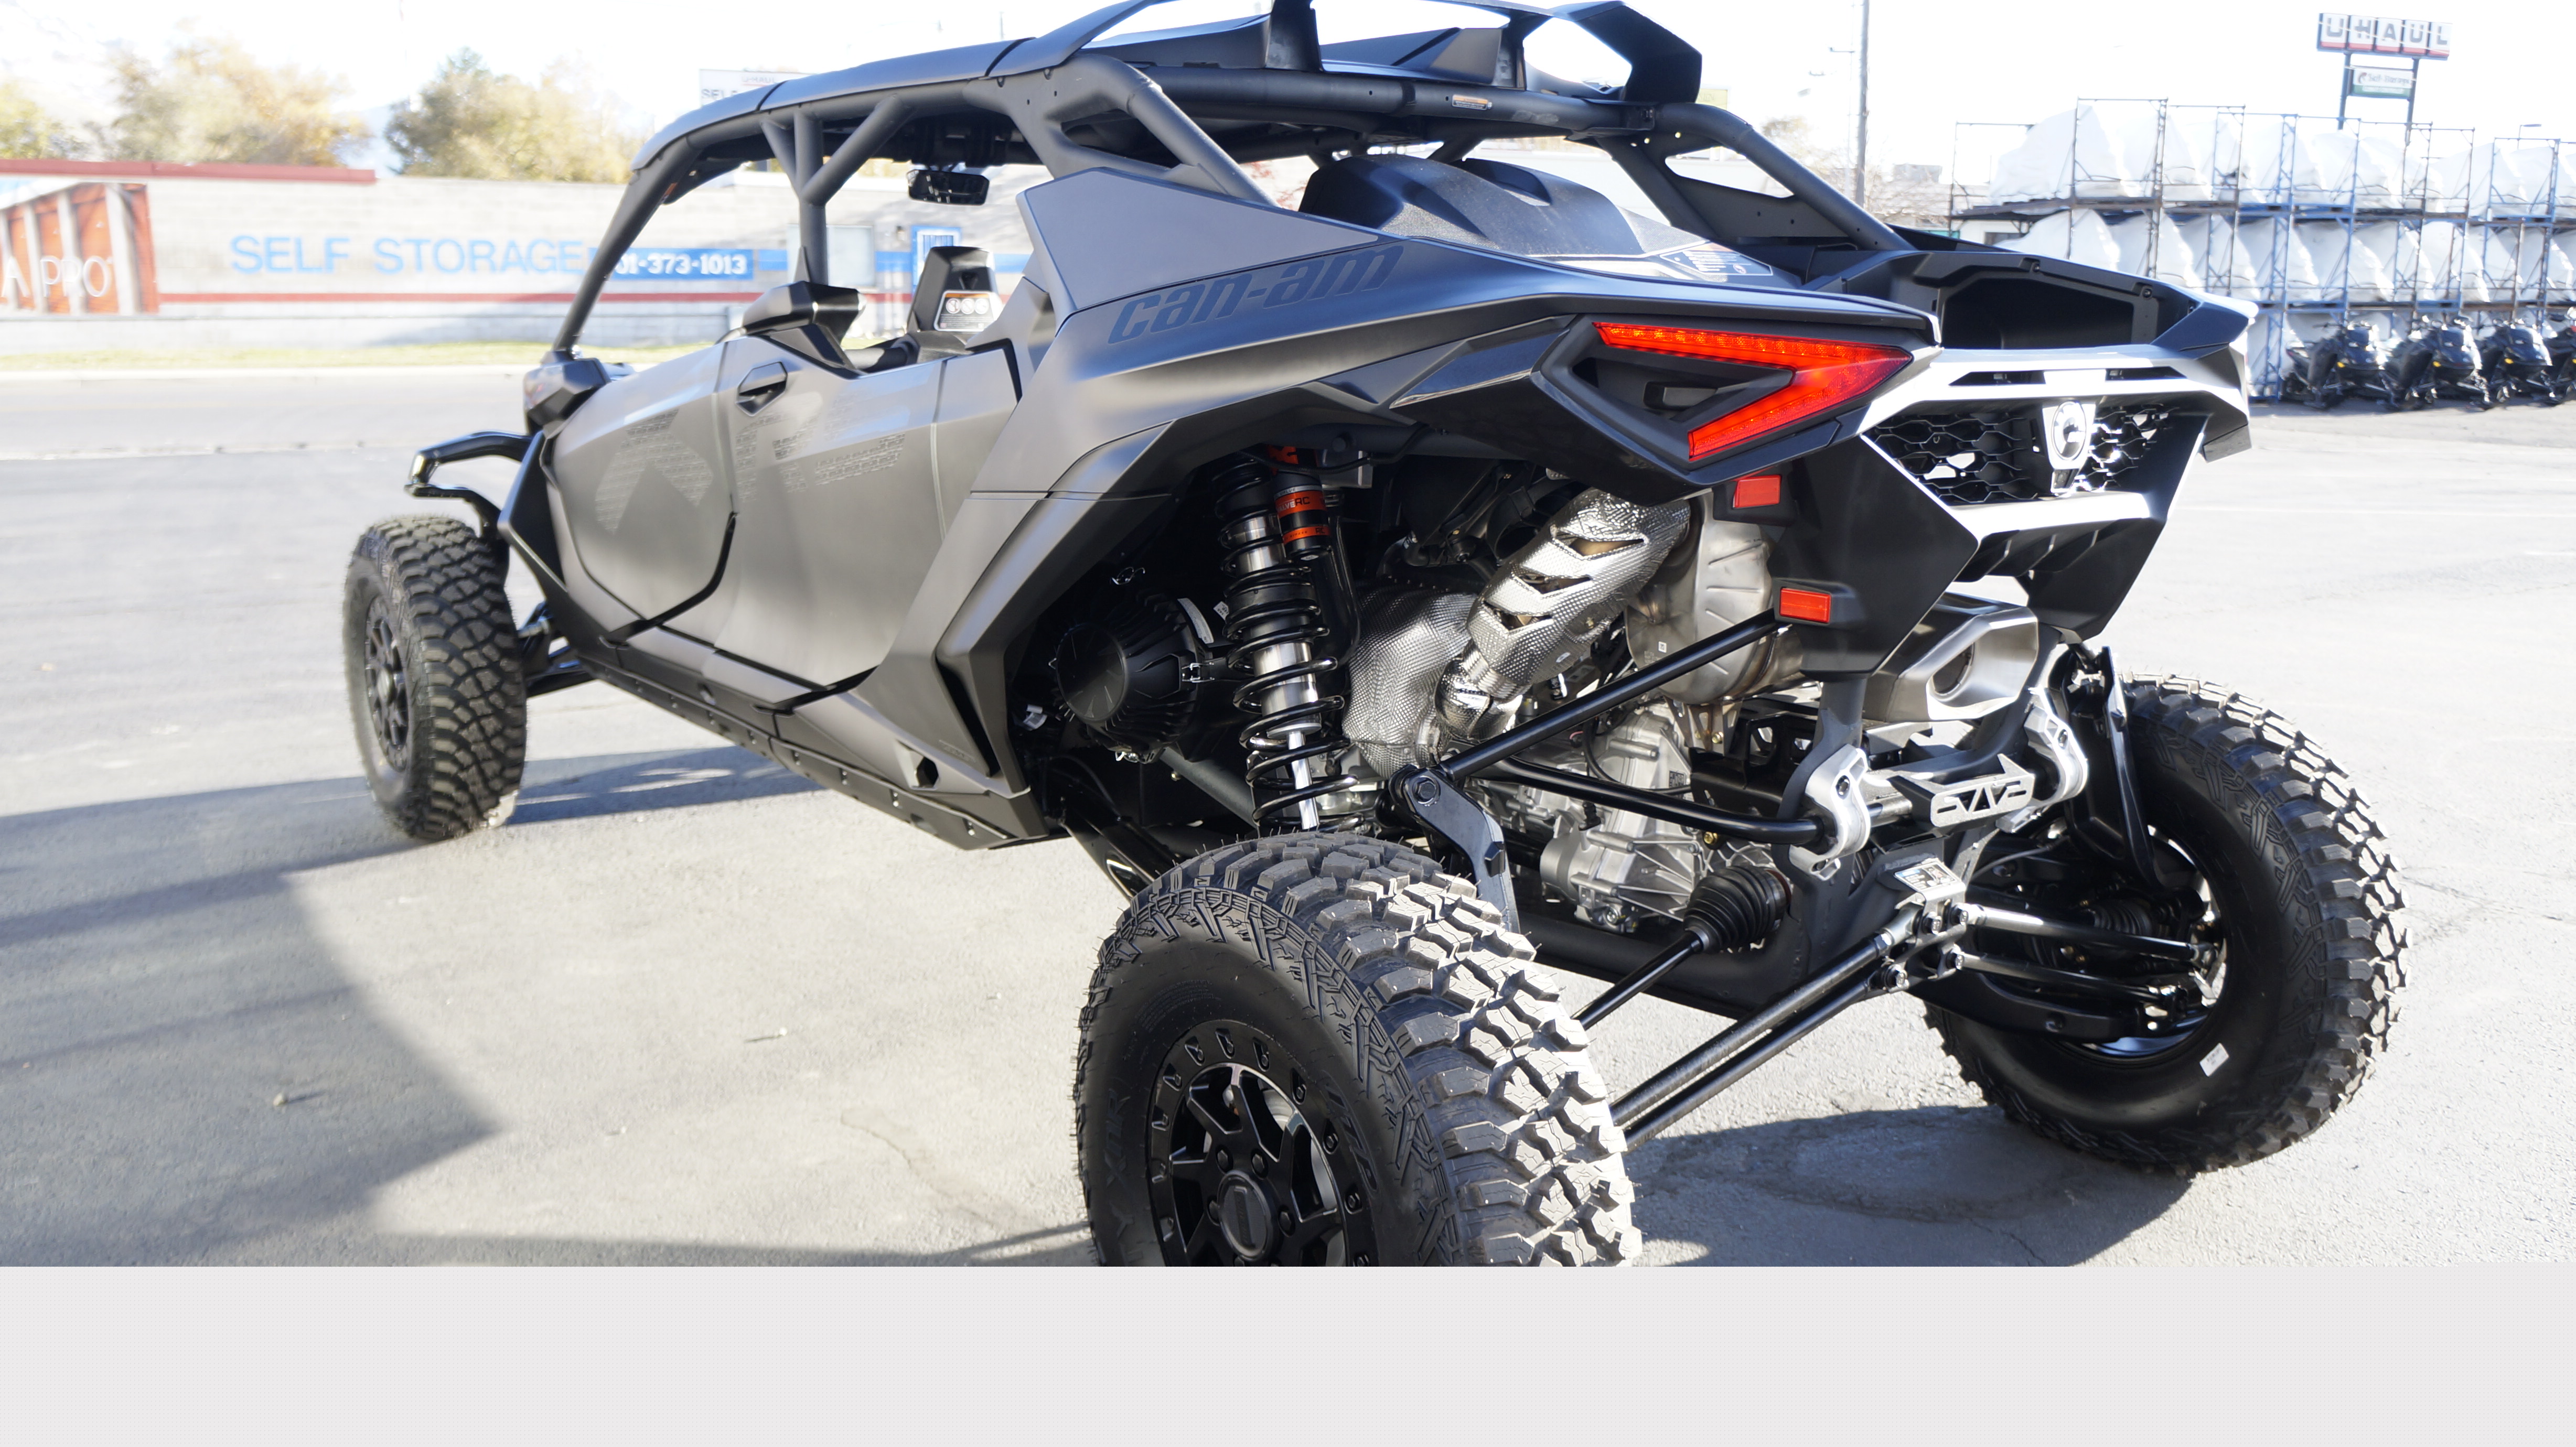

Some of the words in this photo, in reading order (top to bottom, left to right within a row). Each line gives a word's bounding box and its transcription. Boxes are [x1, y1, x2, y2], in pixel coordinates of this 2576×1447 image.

[230, 235, 349, 274] SELF
[373, 237, 583, 274] STORAGE
[40, 256, 111, 297] PRO
